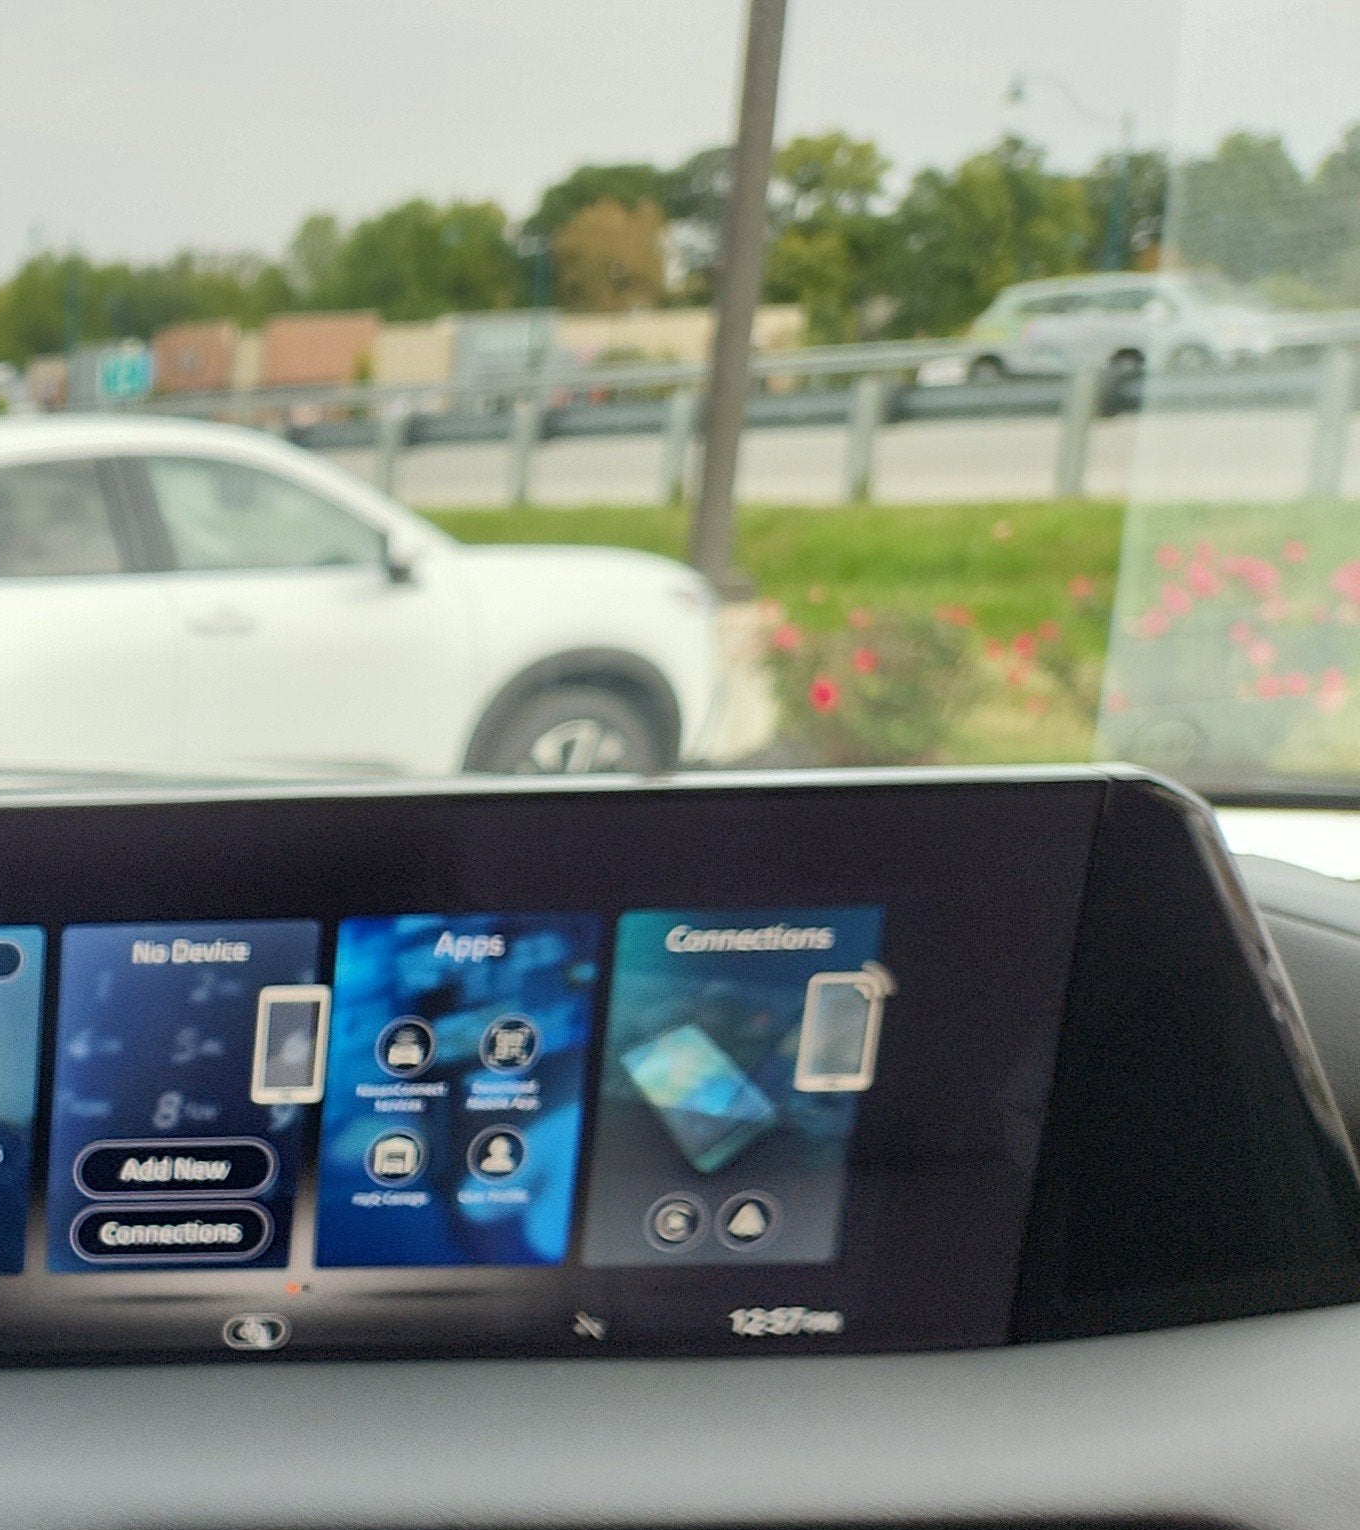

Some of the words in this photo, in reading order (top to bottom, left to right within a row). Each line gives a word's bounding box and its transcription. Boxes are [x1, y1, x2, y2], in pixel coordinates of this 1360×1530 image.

[434, 931, 506, 962] Apps
[665, 923, 836, 953] Connections
[132, 940, 169, 964] No
[172, 939, 251, 964] Device
[120, 1157, 173, 1182] Add
[174, 1158, 231, 1181] New
[99, 1220, 243, 1246] Connections
